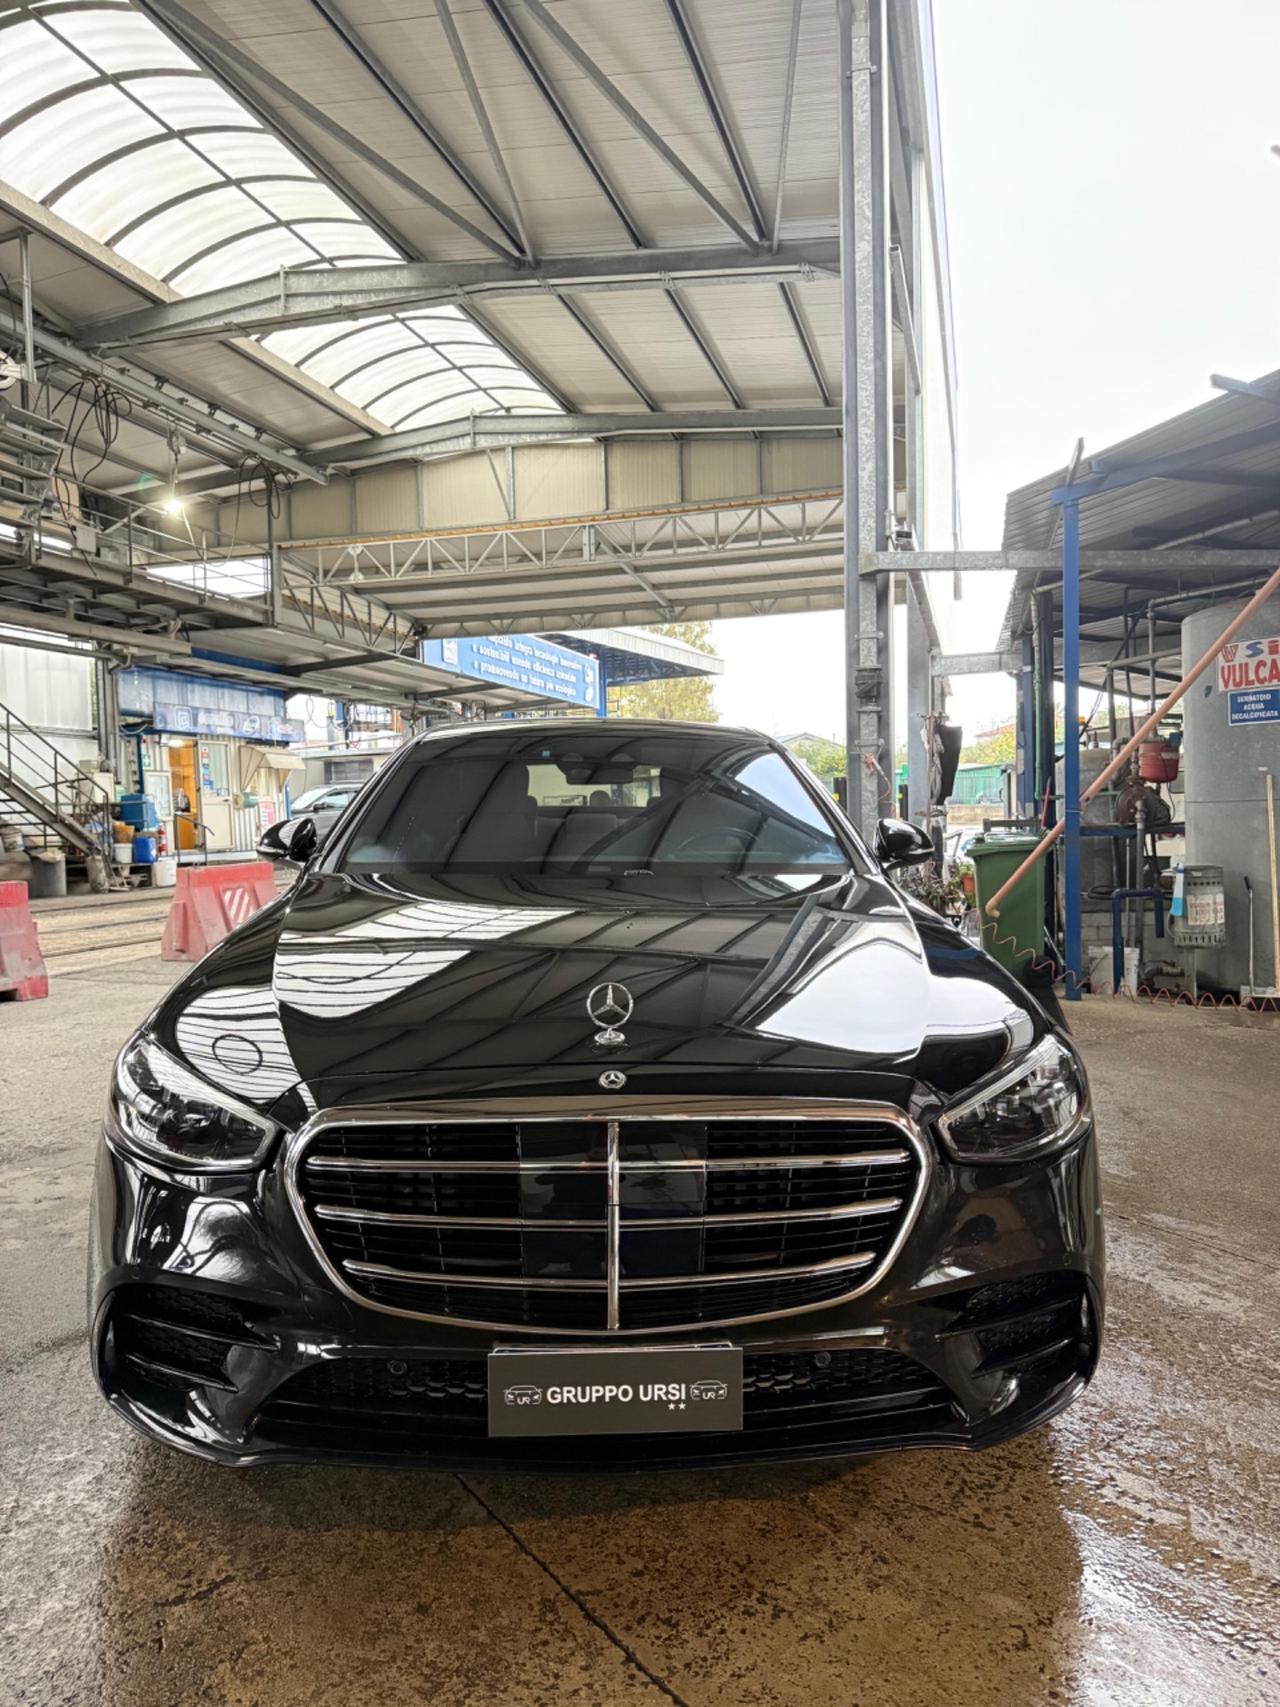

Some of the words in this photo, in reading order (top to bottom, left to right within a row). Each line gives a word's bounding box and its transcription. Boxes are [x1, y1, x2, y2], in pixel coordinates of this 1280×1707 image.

[1243, 703, 1265, 711] ACQUA
[1231, 710, 1279, 720] DECALCIFICATA
[546, 1385, 633, 1404] GRUPPO
[639, 1383, 686, 1401] URSI
